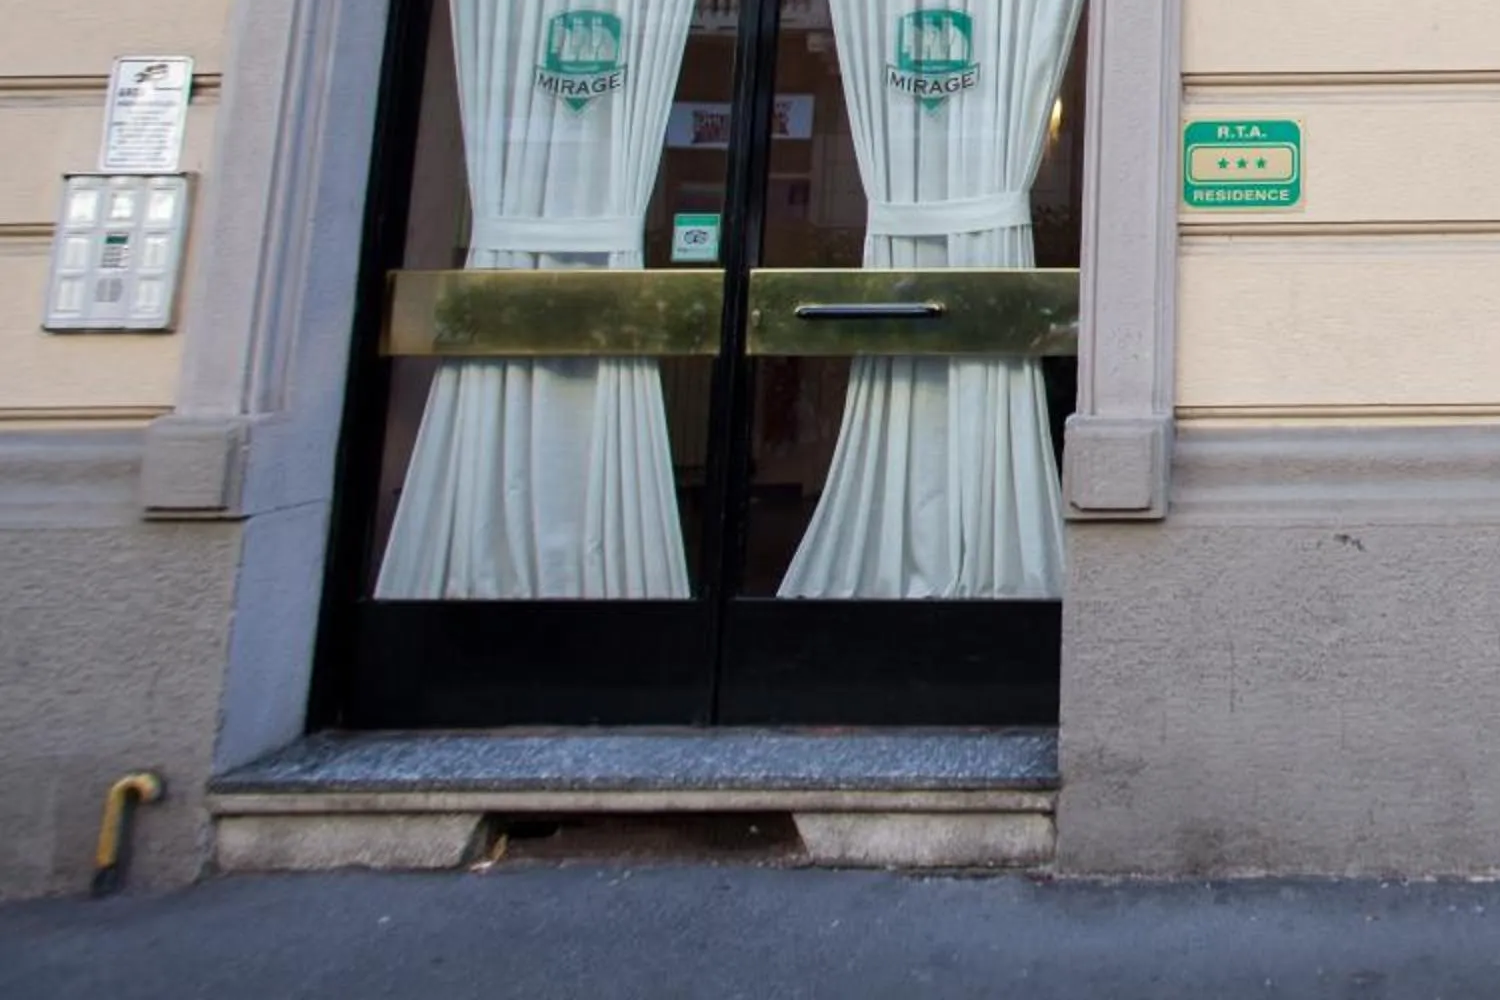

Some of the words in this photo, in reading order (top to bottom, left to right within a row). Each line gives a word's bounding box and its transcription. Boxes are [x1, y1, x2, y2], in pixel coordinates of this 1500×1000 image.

[538, 72, 621, 95] MIRAGE
[890, 71, 975, 94] MIRAGE
[1217, 125, 1267, 139] R.T.A.
[1193, 189, 1290, 202] RESIDENCE
